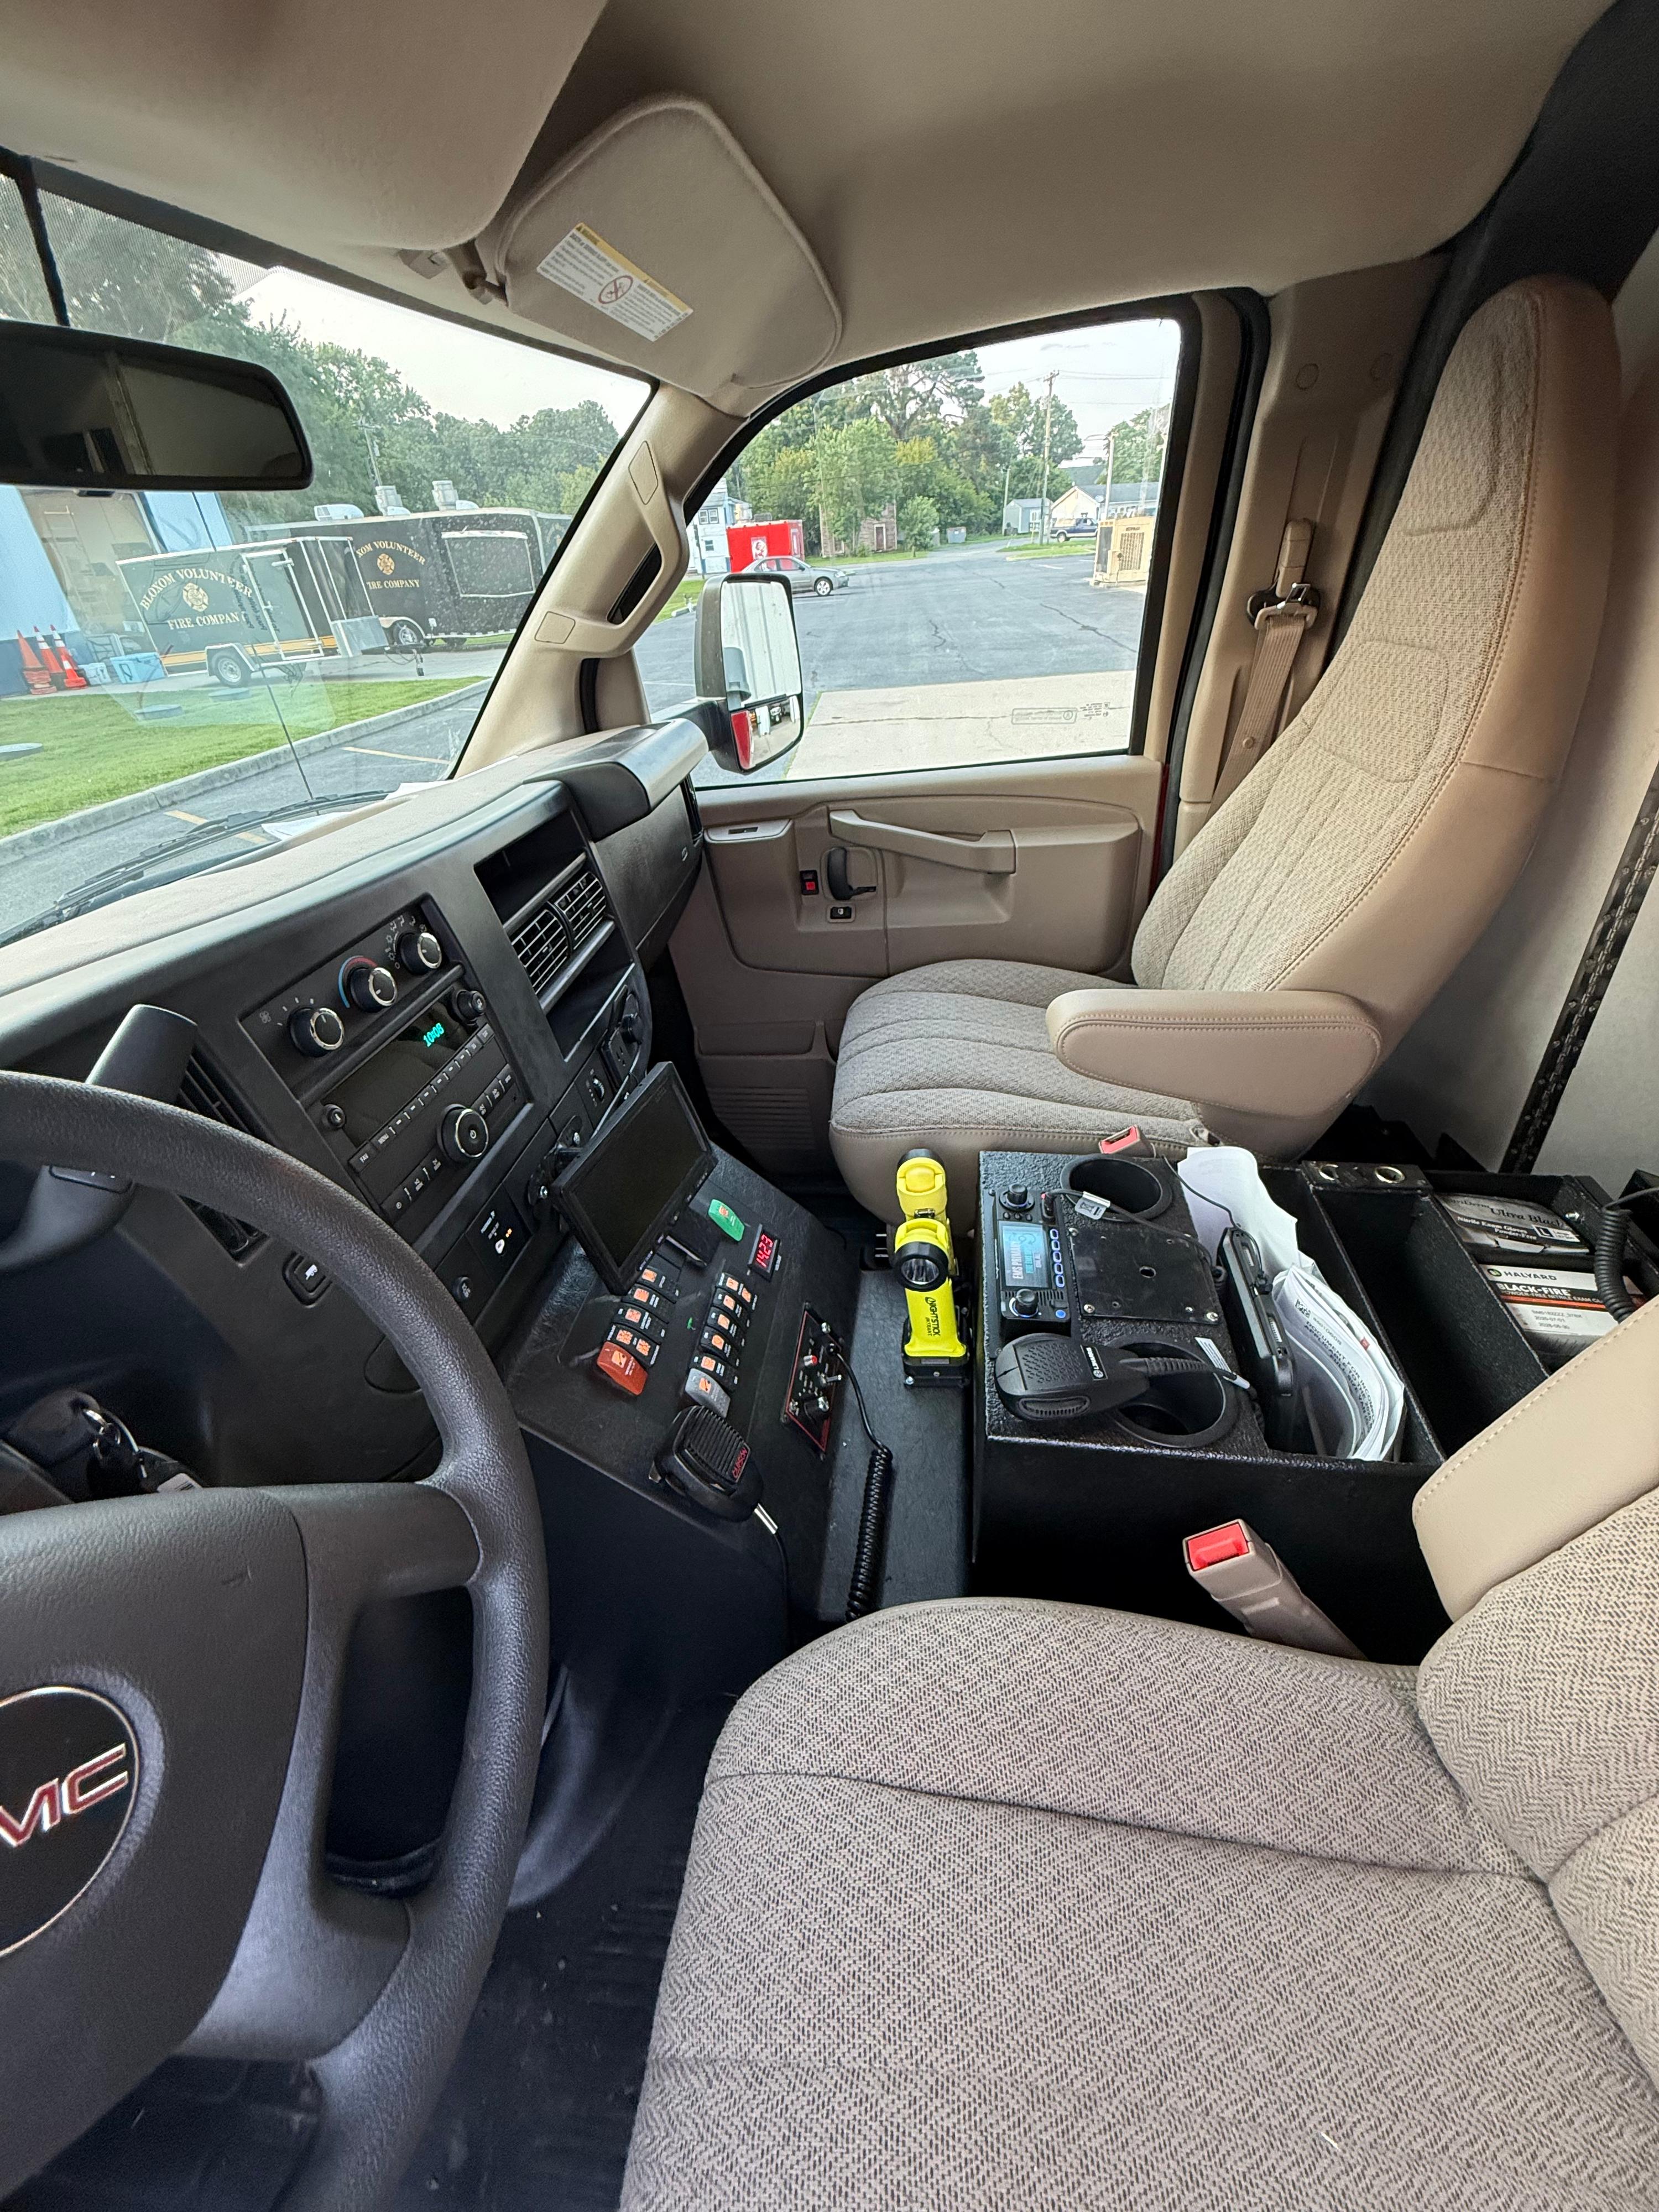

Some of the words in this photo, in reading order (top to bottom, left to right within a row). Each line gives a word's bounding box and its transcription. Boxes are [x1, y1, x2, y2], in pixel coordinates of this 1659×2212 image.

[373, 540, 426, 565] VOLUNTEER
[139, 573, 176, 611] BLOXOM
[175, 568, 253, 598] VOLUNTEER
[383, 579, 420, 589] COMPANY
[168, 617, 194, 630] FIRE
[359, 1153, 369, 1163] FAV
[1491, 1208, 1525, 1220] Ultra
[1457, 1216, 1480, 1225] Nitrile
[1481, 1220, 1503, 1229] Exam
[1504, 1225, 1527, 1234] Gloves
[1495, 1228, 1537, 1240] Powder-Free
[1539, 1228, 1550, 1237] L
[1012, 1266, 1023, 1279] EMS
[1504, 1271, 1557, 1281] HALYARD
[1496, 1282, 1571, 1296] BLACK-FIRE
[925, 1297, 941, 1336] NIGHTSTICK
[1306, 1321, 1346, 1360] DOCUMENT
[1347, 1360, 1361, 1378] FOR
[1304, 1324, 1348, 1369] APPLICABLE
[1349, 1369, 1357, 1382] TO
[1356, 1381, 1366, 1397] THE
[1329, 1354, 1347, 1375] FULL
[1347, 1374, 1359, 1390] SIZE
[1358, 1394, 1366, 1414] VAN
[732, 1447, 748, 1479] CARSON
